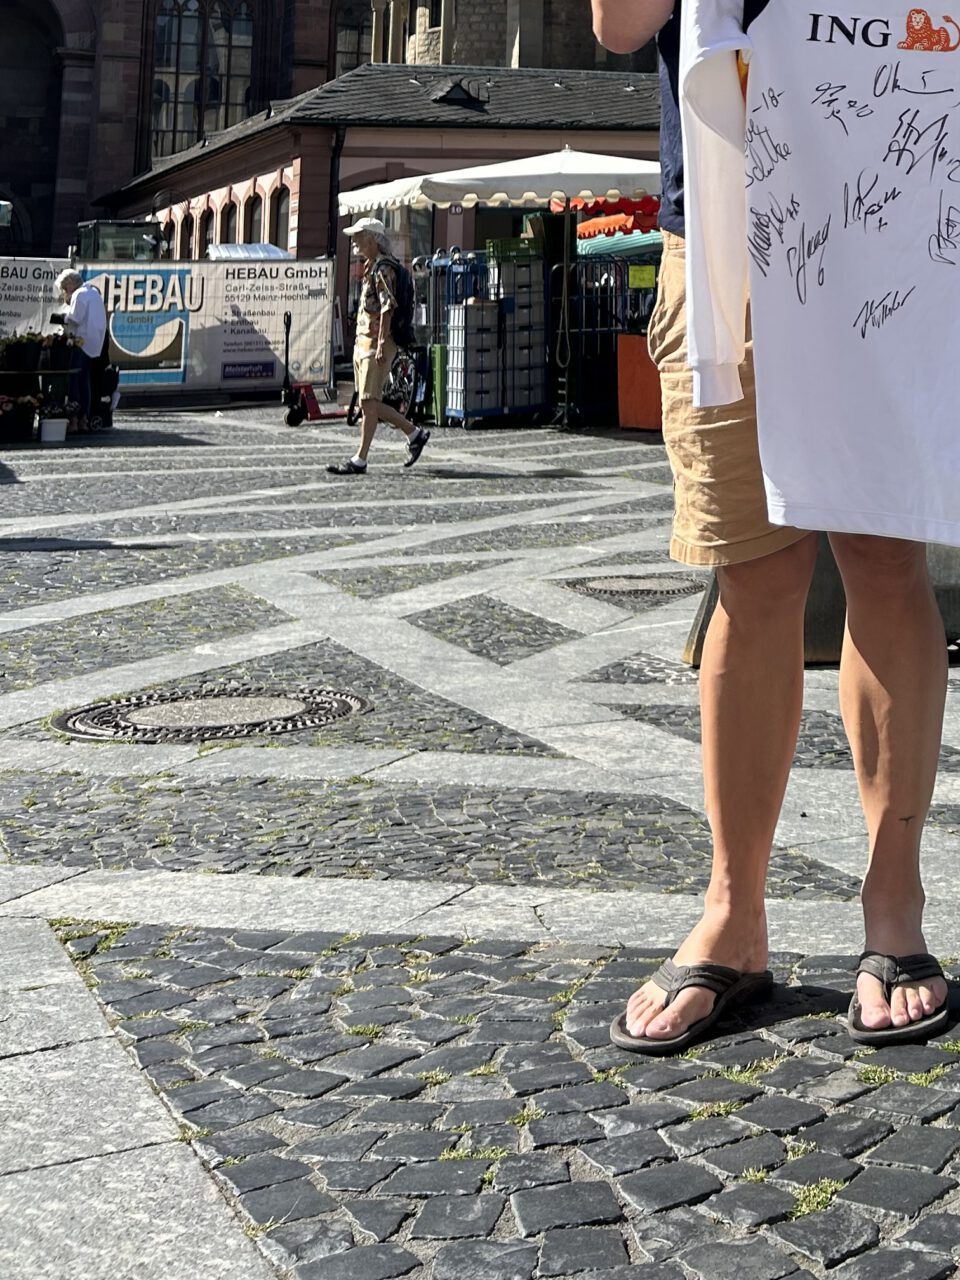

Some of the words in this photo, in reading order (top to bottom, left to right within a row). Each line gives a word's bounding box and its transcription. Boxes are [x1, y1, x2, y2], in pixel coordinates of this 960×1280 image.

[806, 13, 892, 48] ING
[32, 267, 64, 280] Gmb
[225, 267, 279, 280] HEBAU
[284, 266, 328, 279] GmbH
[107, 274, 204, 312] HEBAU
[225, 282, 311, 293] Carl-Zeiss-Straße
[231, 309, 275, 317] Straßenbau
